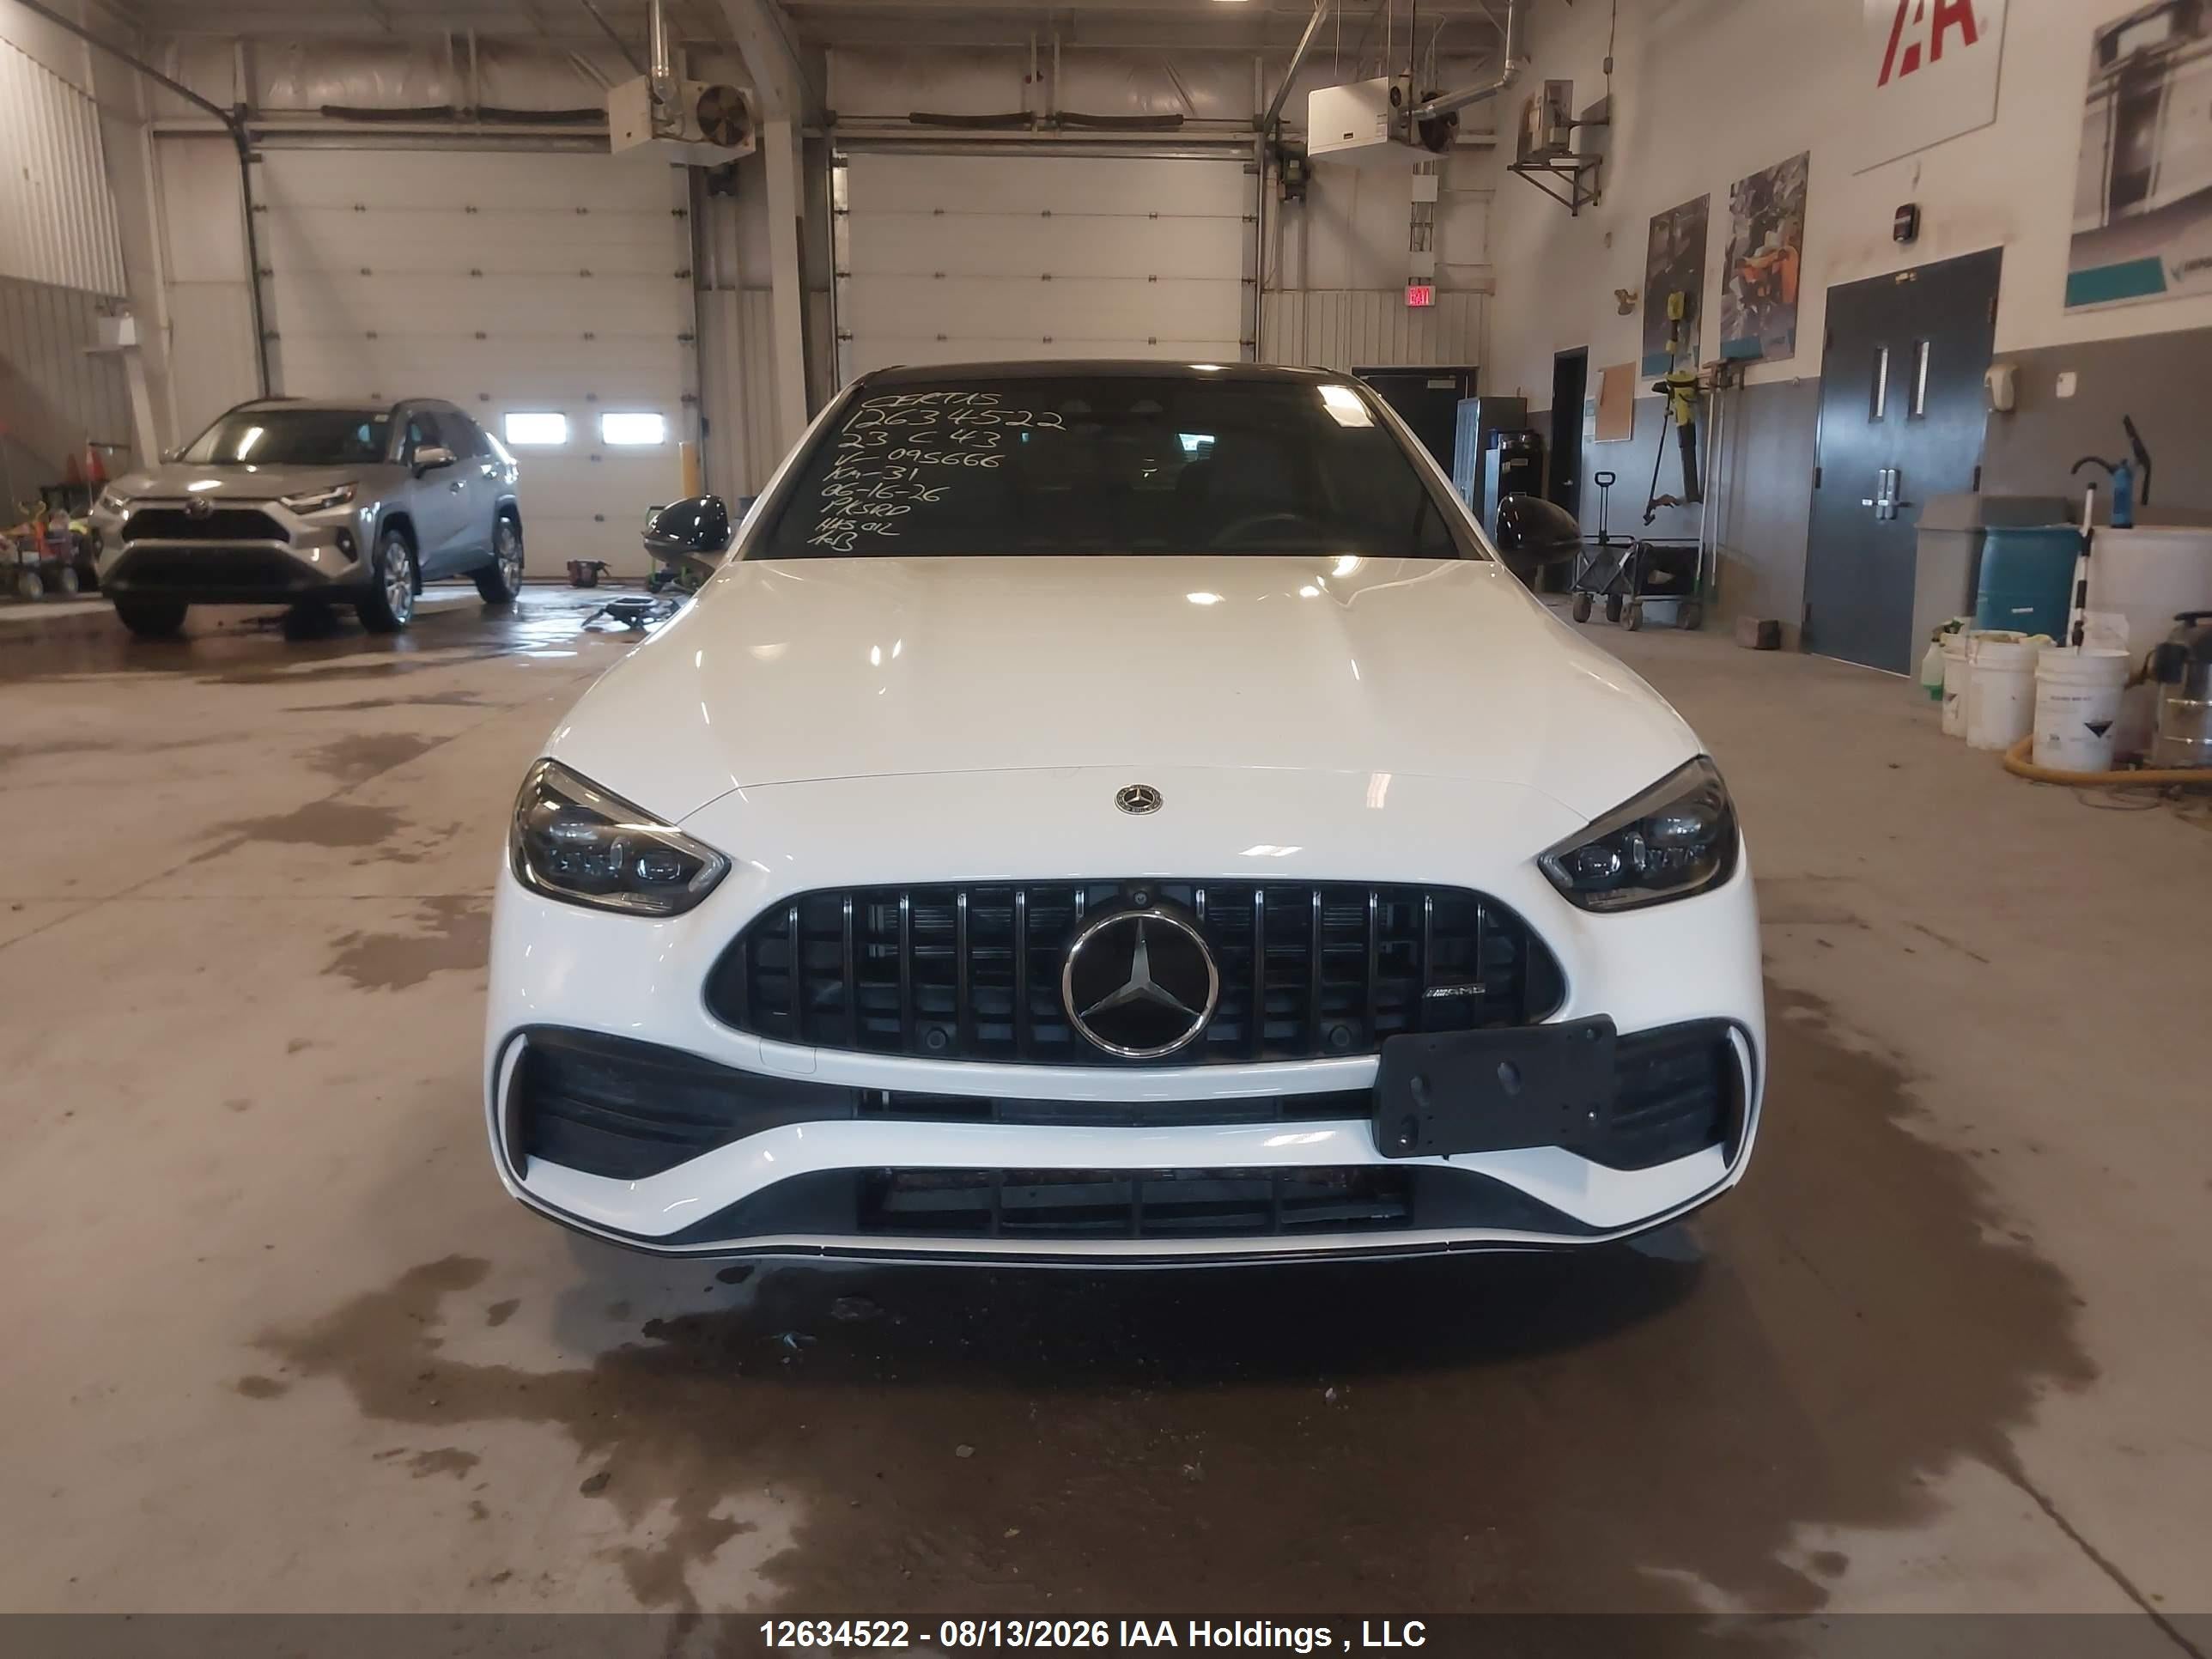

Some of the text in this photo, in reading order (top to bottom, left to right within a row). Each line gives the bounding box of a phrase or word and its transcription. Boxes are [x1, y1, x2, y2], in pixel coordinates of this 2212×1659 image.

[838, 431, 890, 448] 23
[949, 428, 1001, 448] 43
[887, 447, 1006, 468] 095666
